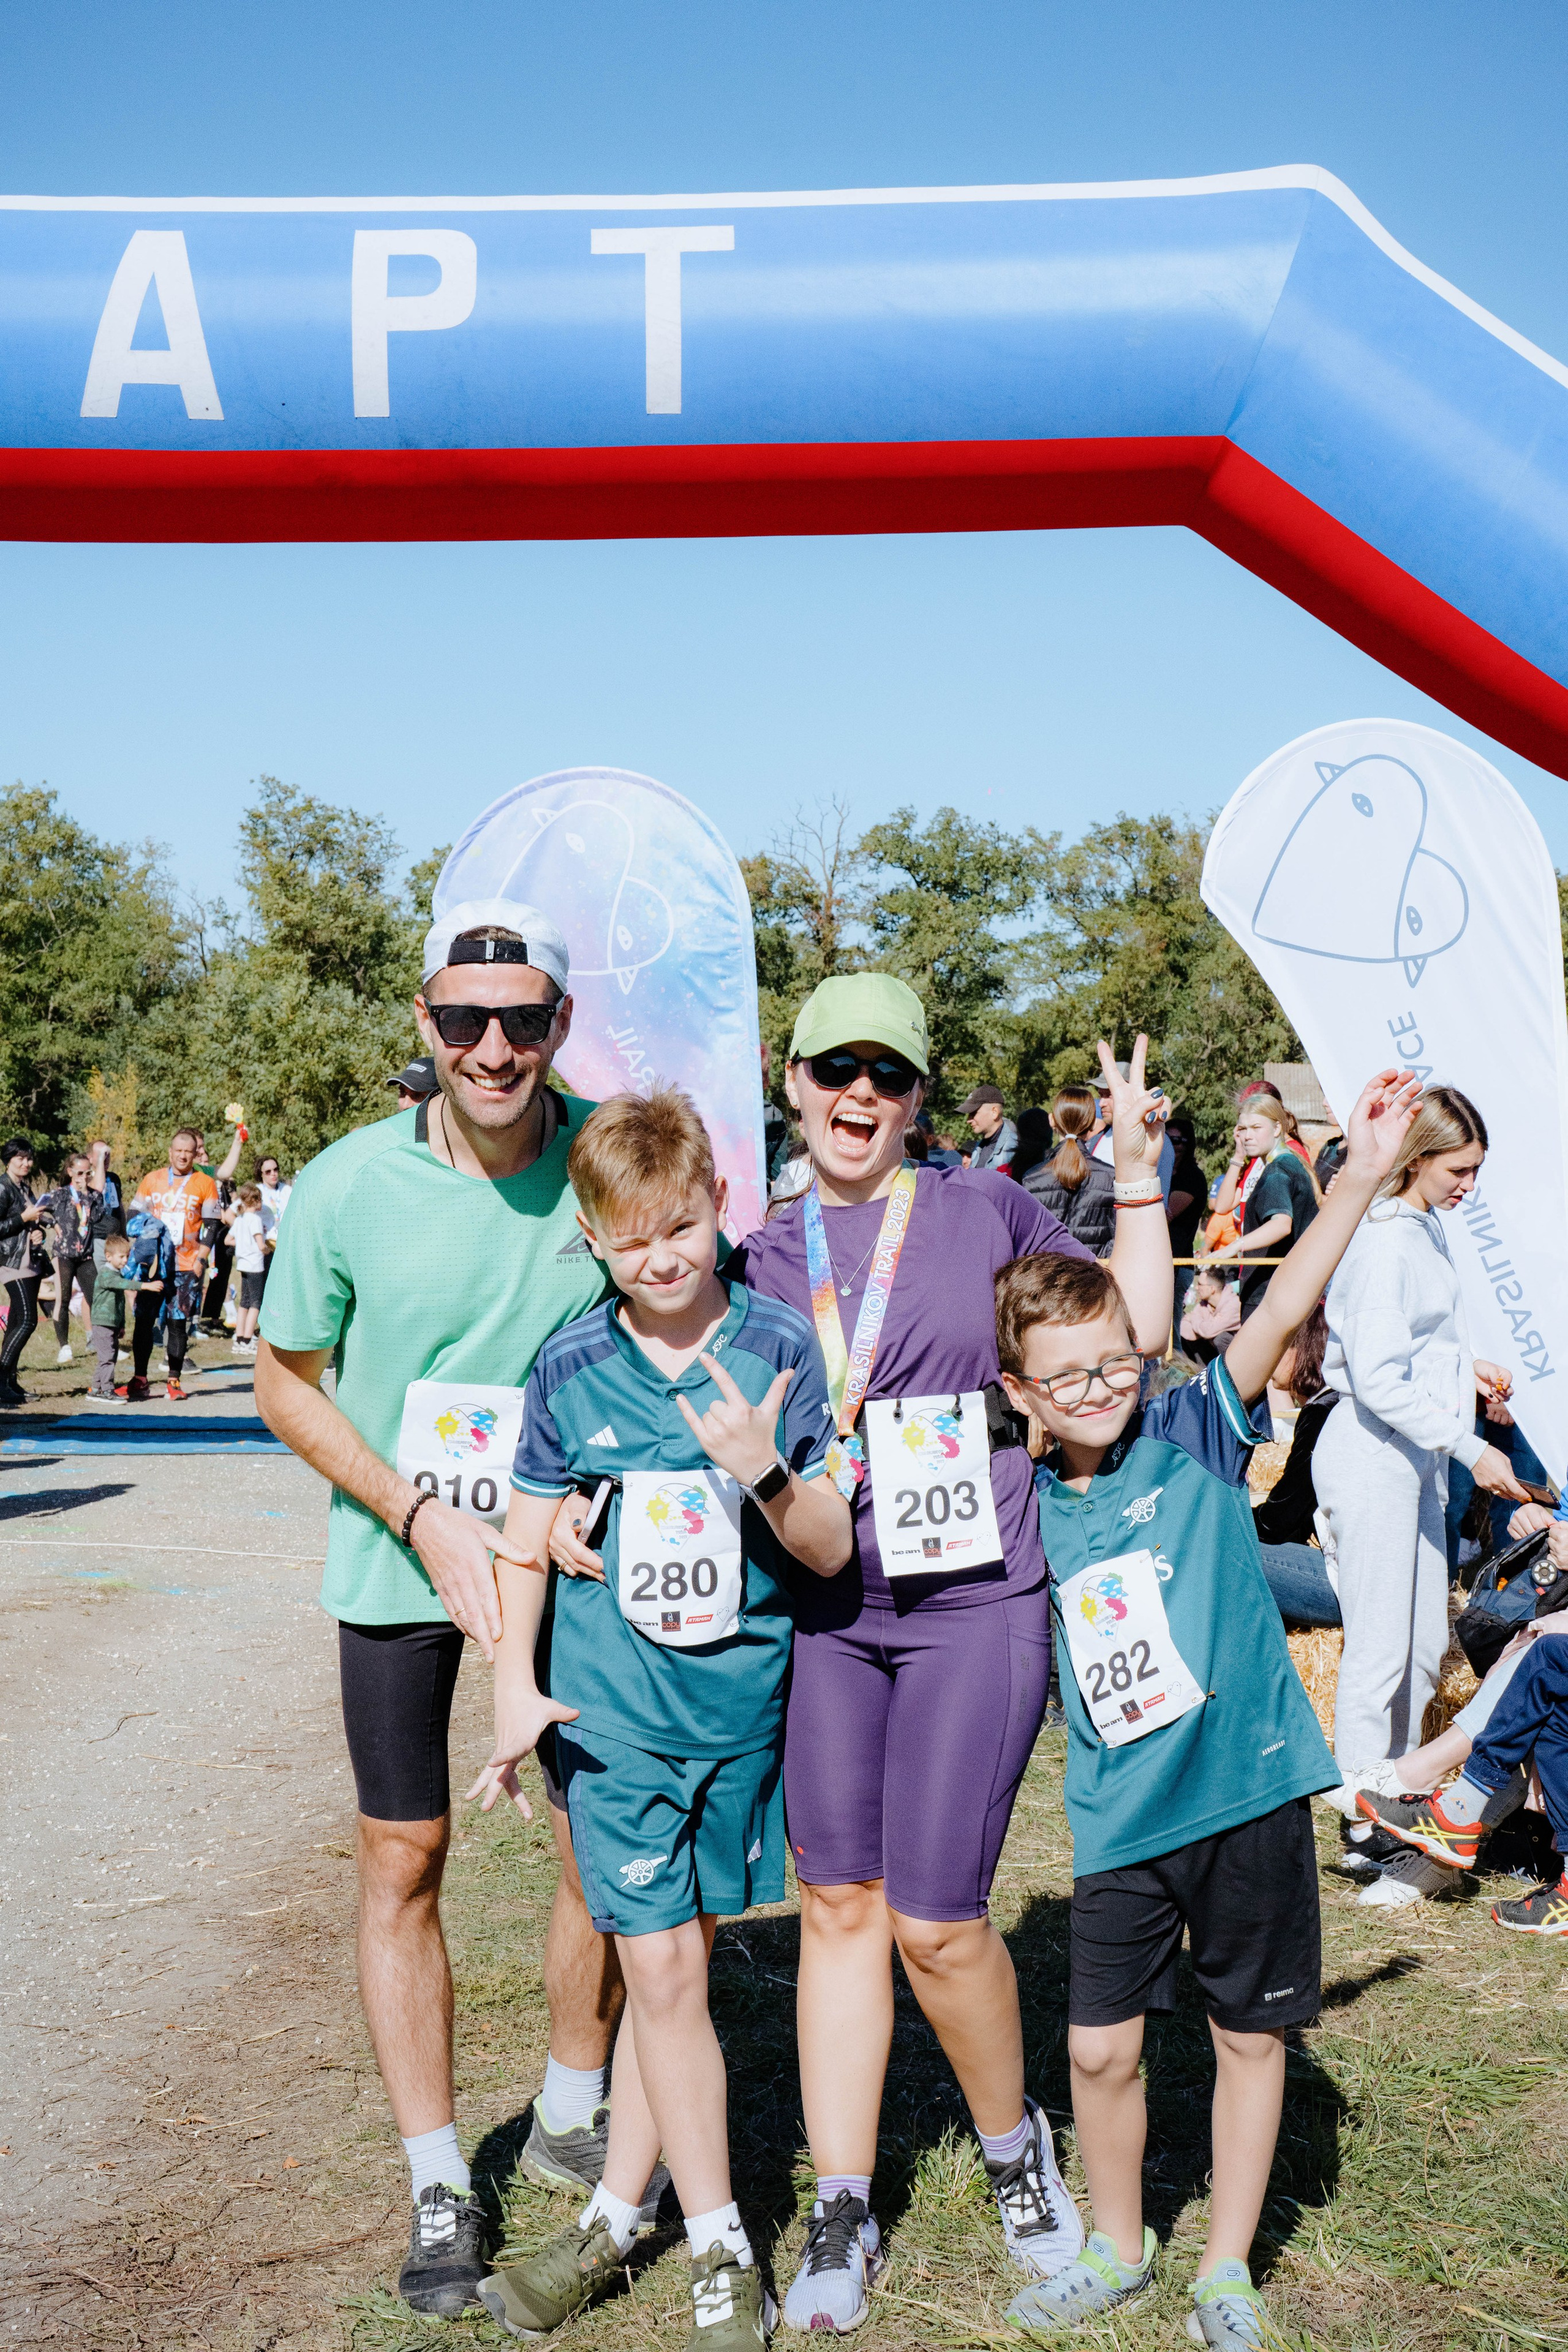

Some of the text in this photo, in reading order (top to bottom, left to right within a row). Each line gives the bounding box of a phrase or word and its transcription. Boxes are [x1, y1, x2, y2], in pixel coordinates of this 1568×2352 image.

[845, 1188, 910, 1406] KRASILNIKOV TRAIL 2023
[895, 1480, 979, 1529] 203
[631, 1558, 718, 1602] 280
[662, 1621, 681, 1629] copy
[1085, 1640, 1160, 1705] 282
[1125, 1709, 1141, 1721] copy
[1262, 1740, 1286, 1756] AEROREADY
[1273, 1987, 1294, 1999] reima
